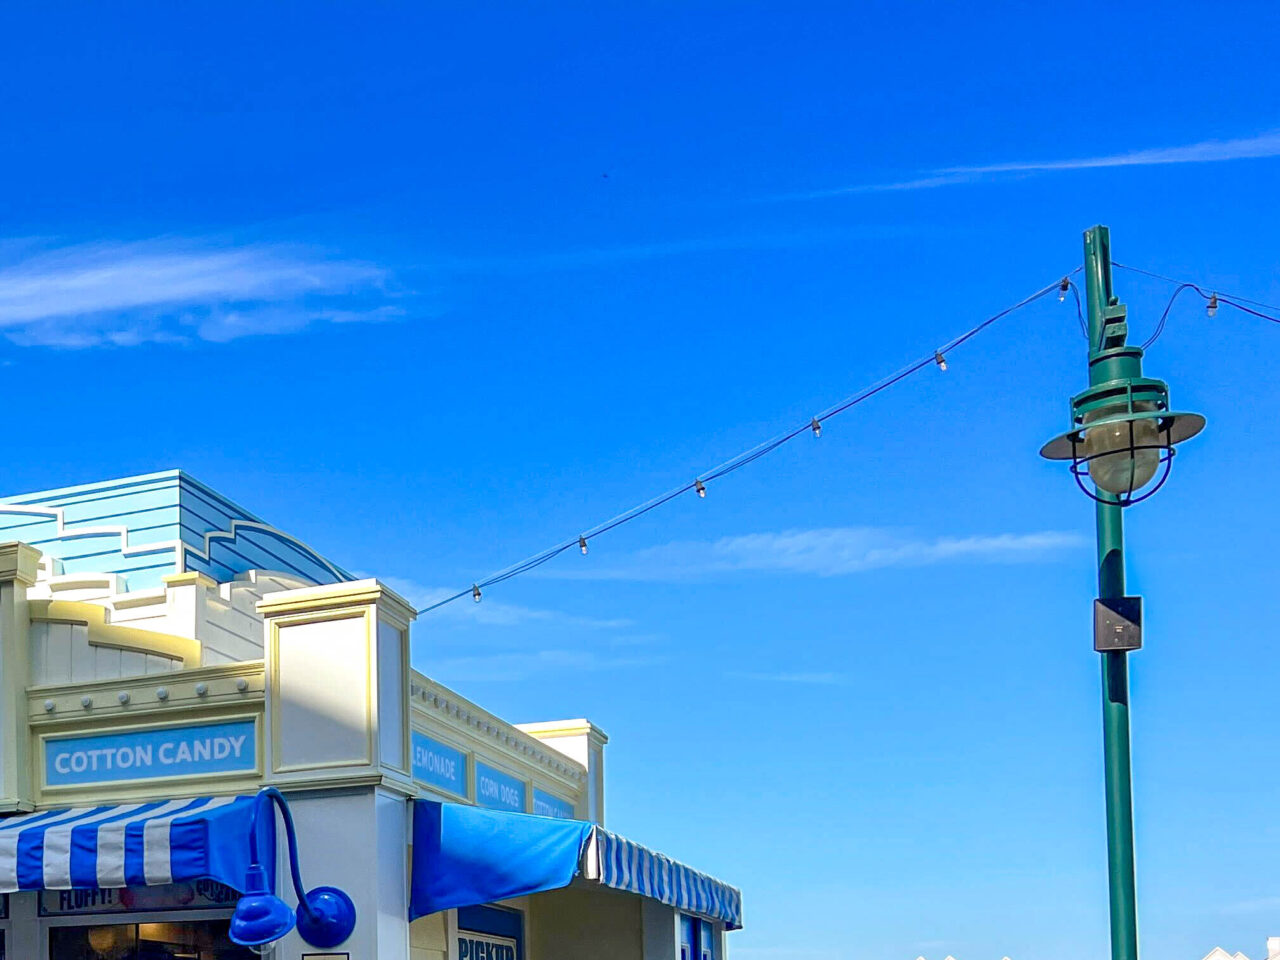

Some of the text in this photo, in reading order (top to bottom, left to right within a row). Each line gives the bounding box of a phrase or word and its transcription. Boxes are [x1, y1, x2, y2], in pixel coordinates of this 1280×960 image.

[55, 735, 246, 774] COTTON CANDY
[411, 743, 456, 781] LEMONADE
[480, 776, 519, 807] CORN DOGS
